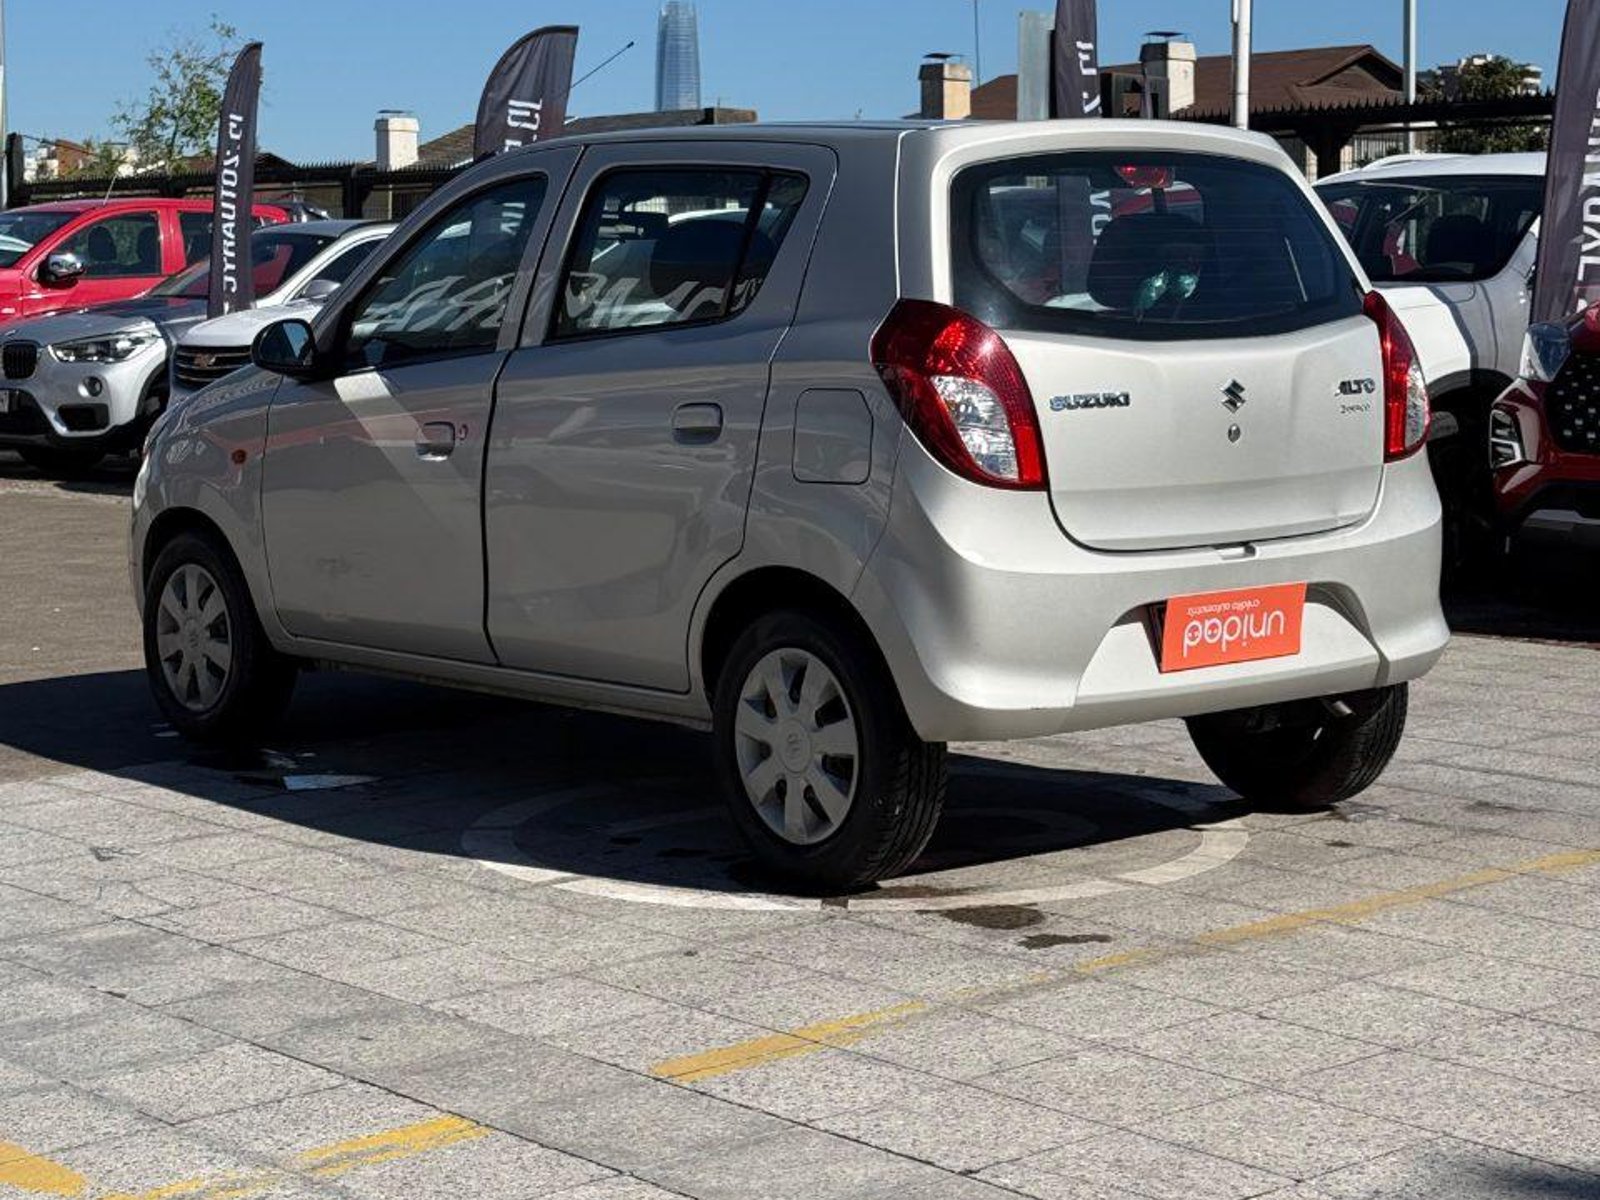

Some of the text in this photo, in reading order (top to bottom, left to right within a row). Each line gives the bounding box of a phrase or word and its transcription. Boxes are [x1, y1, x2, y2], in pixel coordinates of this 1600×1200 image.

[1334, 378, 1375, 397] ALTO
[1049, 391, 1130, 411] SUZUKI
[1182, 610, 1285, 658] unidad
